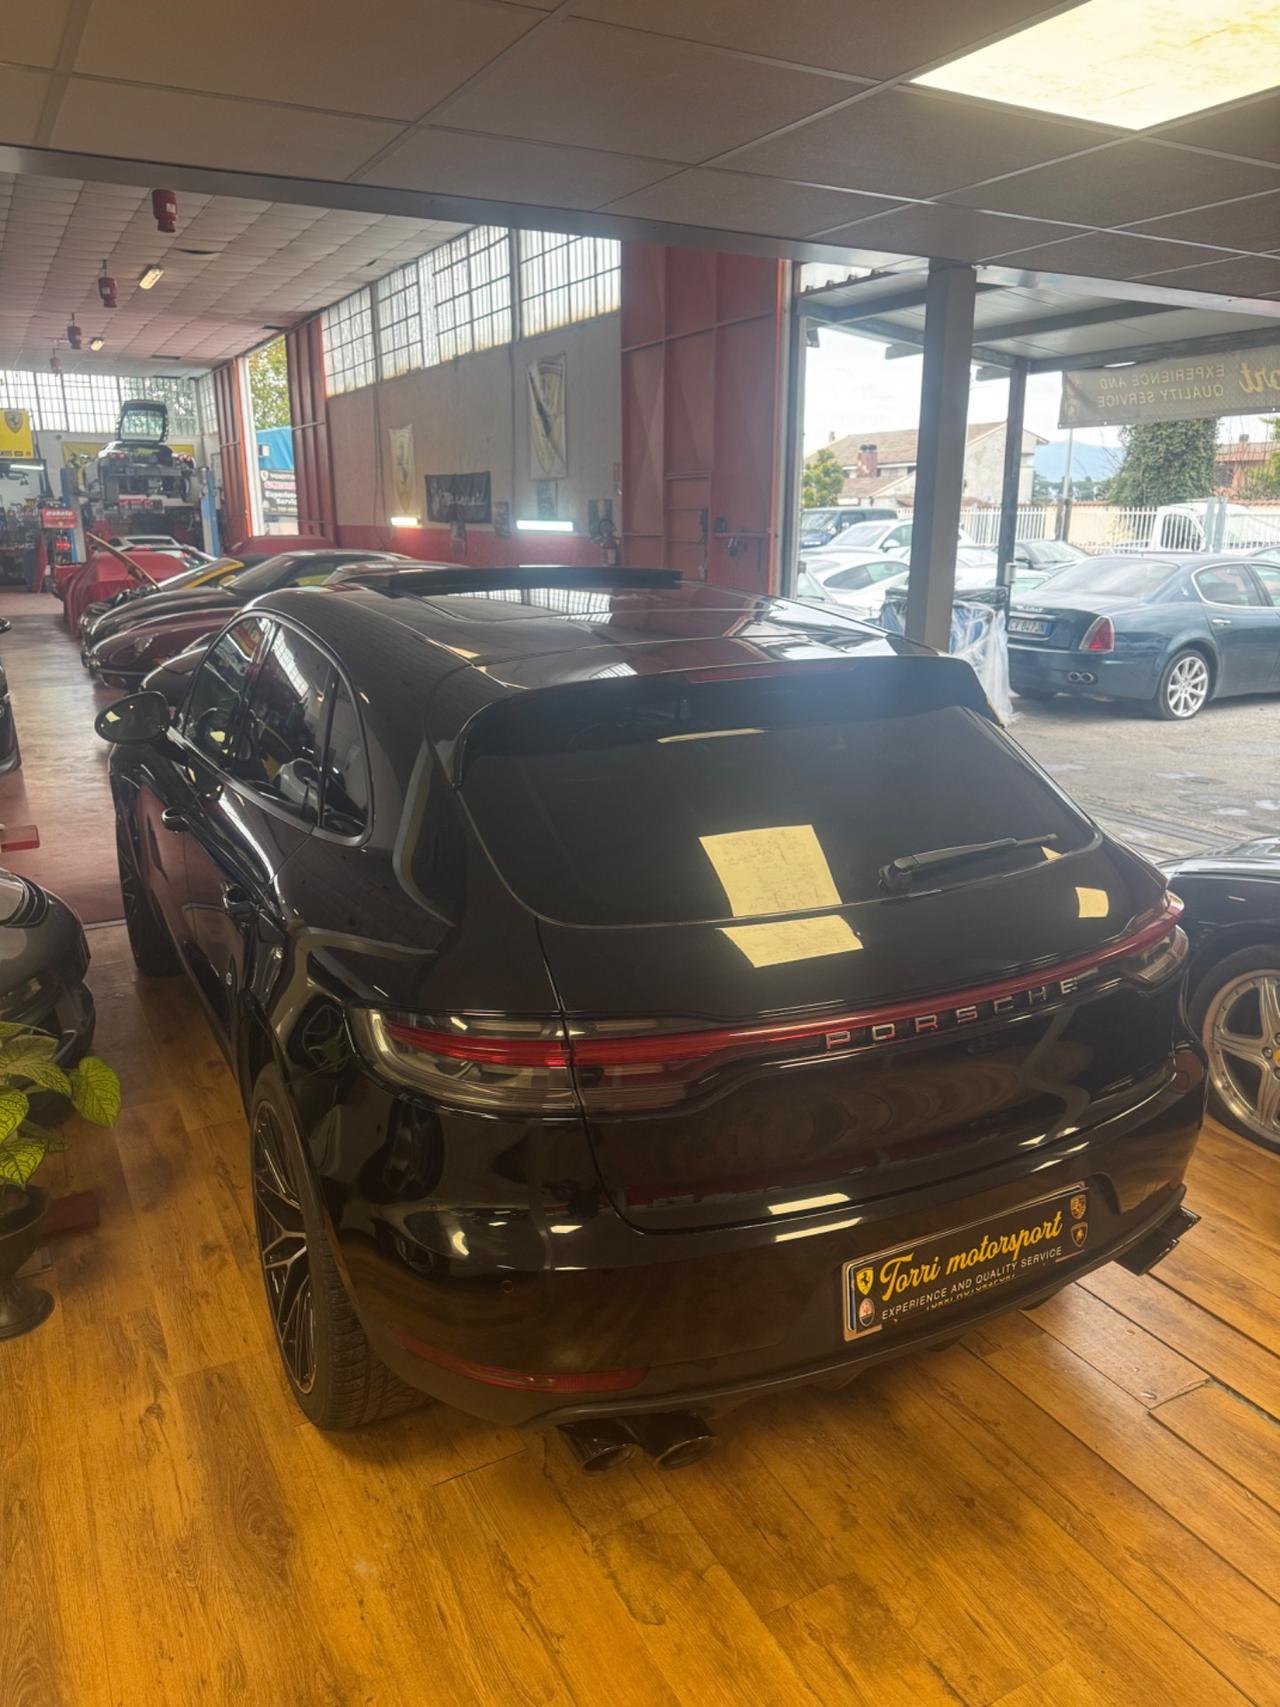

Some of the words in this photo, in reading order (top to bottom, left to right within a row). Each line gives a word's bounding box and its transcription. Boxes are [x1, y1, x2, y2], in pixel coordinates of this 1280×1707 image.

[825, 978, 1077, 1050] PORSCHE
[880, 1252, 941, 1302] Torri
[946, 1210, 1063, 1275] motorsport
[882, 1288, 947, 1320] EXPERIENCE
[951, 1278, 973, 1293] AND
[976, 1261, 1018, 1285] QUALITY
[1020, 1246, 1062, 1269] SERVICE
